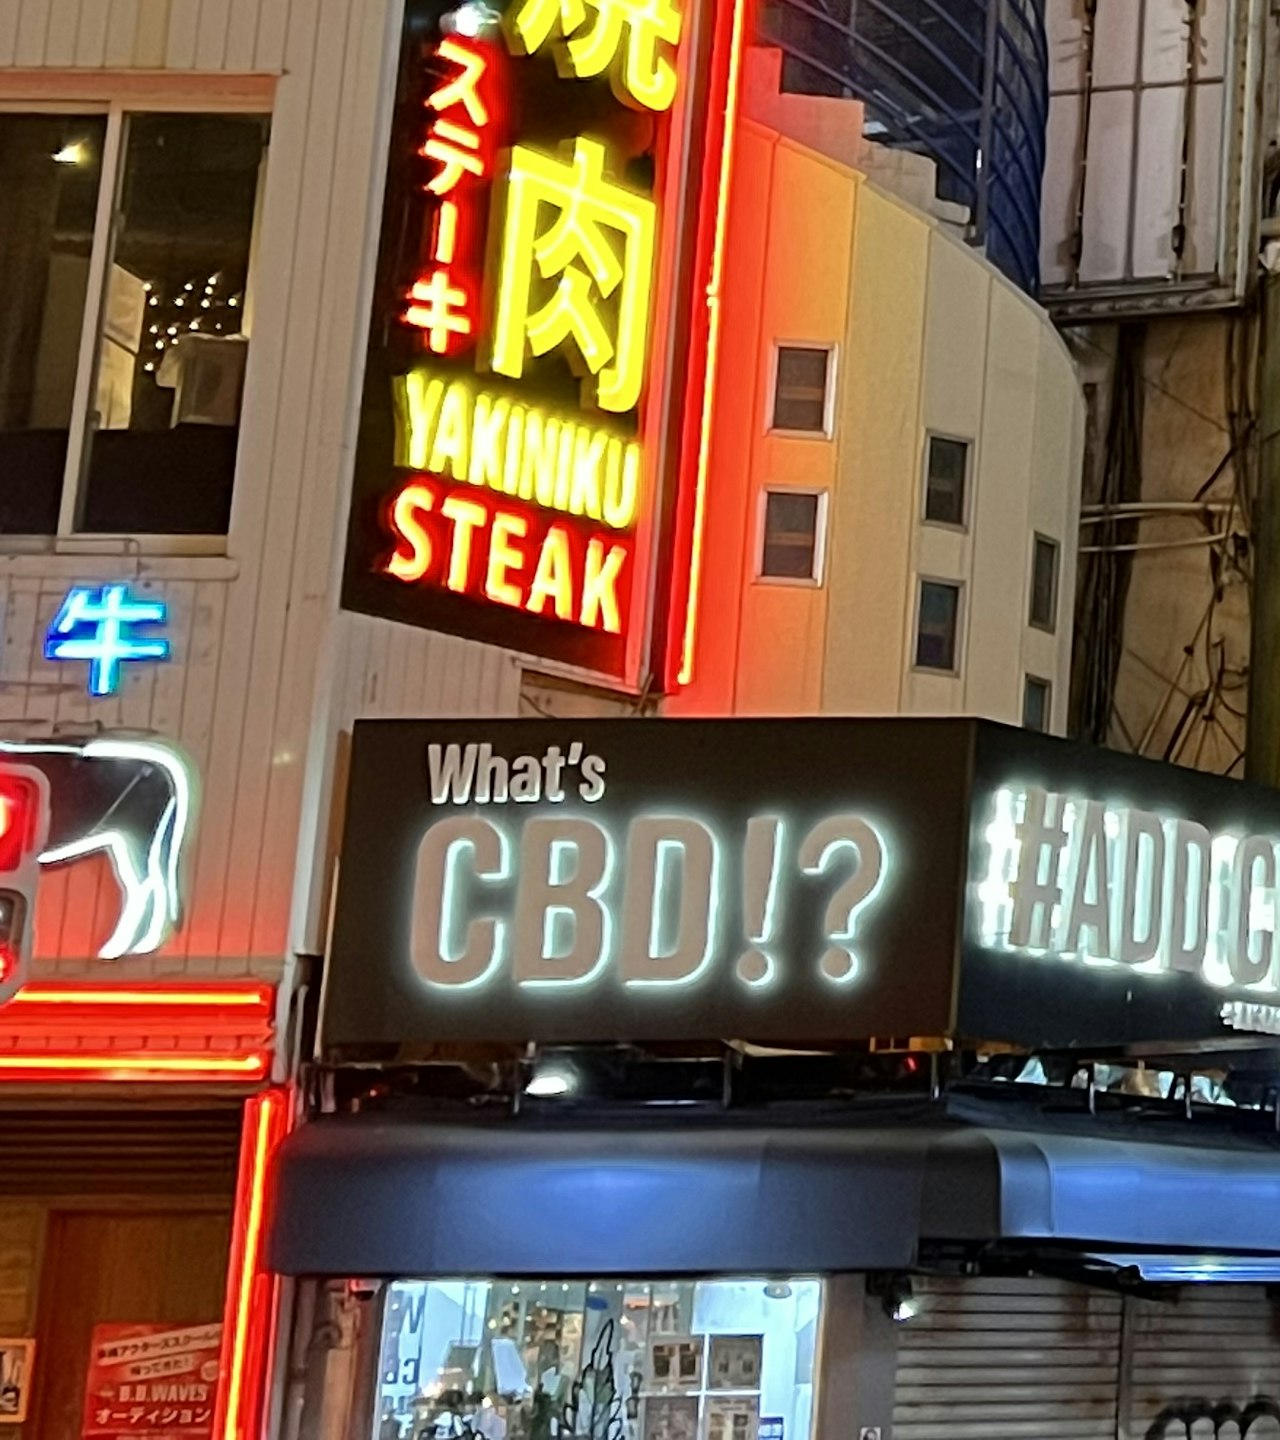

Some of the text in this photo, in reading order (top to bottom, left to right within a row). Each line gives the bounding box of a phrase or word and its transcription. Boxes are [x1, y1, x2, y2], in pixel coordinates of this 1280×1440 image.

[405, 38, 490, 357] ステーキ
[396, 368, 642, 529] YAKINIKU
[386, 484, 628, 635] STEAK
[48, 582, 169, 696] 牛
[427, 741, 607, 805] What's
[409, 814, 888, 990] CBD!?
[95, 1406, 212, 1426] オーディション
